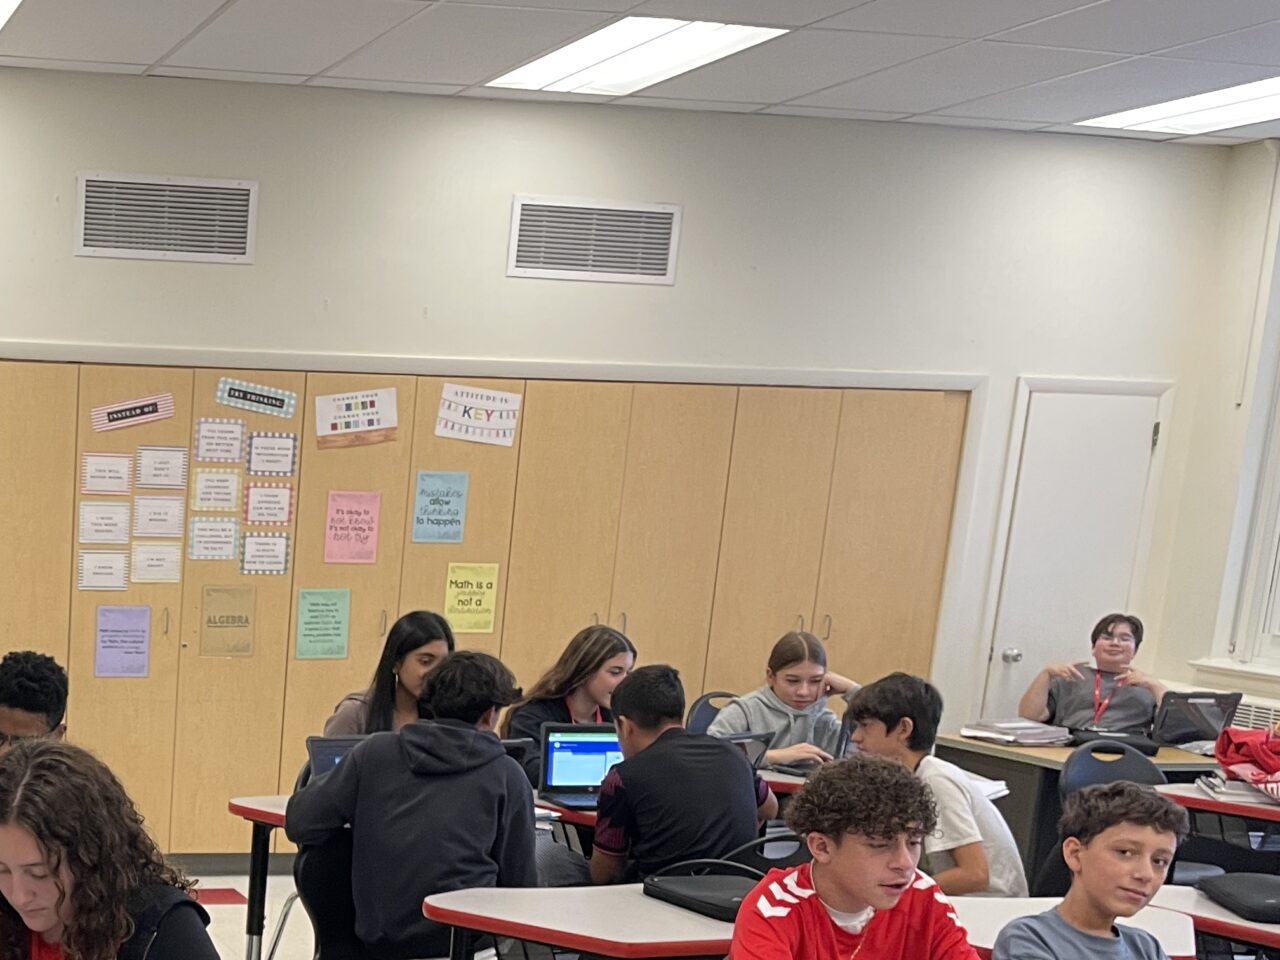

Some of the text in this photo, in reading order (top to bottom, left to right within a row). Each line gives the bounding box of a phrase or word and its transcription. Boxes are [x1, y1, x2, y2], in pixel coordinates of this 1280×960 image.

[454, 390, 496, 402] ATTITUDE
[461, 405, 495, 422] KEY
[429, 497, 451, 506] allow
[426, 516, 461, 527] happen
[449, 579, 493, 590] Math is a
[457, 596, 482, 607] not a
[206, 615, 250, 626] ALGEBRA
